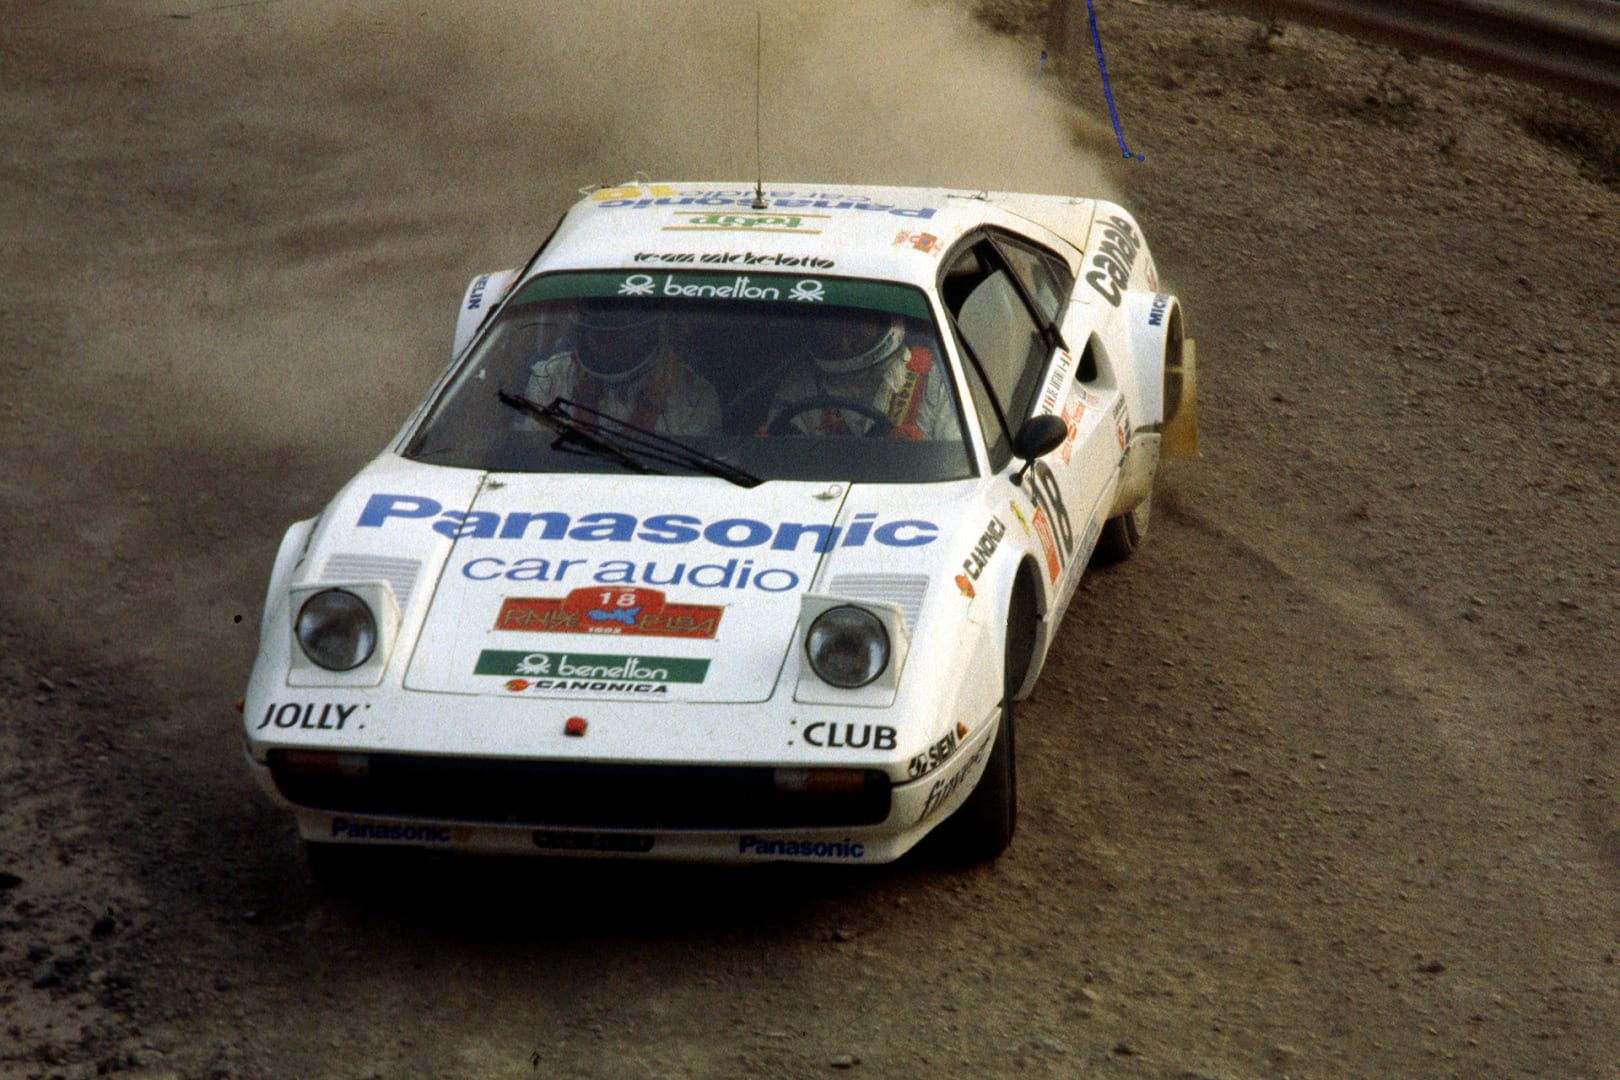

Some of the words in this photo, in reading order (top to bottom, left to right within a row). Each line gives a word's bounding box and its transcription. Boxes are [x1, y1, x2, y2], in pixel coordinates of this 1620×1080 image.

[598, 197, 937, 219] Panasonic
[633, 251, 695, 264] team
[663, 274, 780, 301] benetton
[356, 493, 939, 554] Panasonic
[462, 556, 588, 583] car
[593, 558, 800, 593] audio
[600, 592, 637, 608] 18
[557, 655, 668, 681] benetton
[534, 679, 669, 695] CANONICA
[257, 702, 357, 731] JOLLY
[802, 721, 899, 751] CLUB
[331, 817, 452, 844] Panasonic
[738, 836, 866, 859] Panasonic
